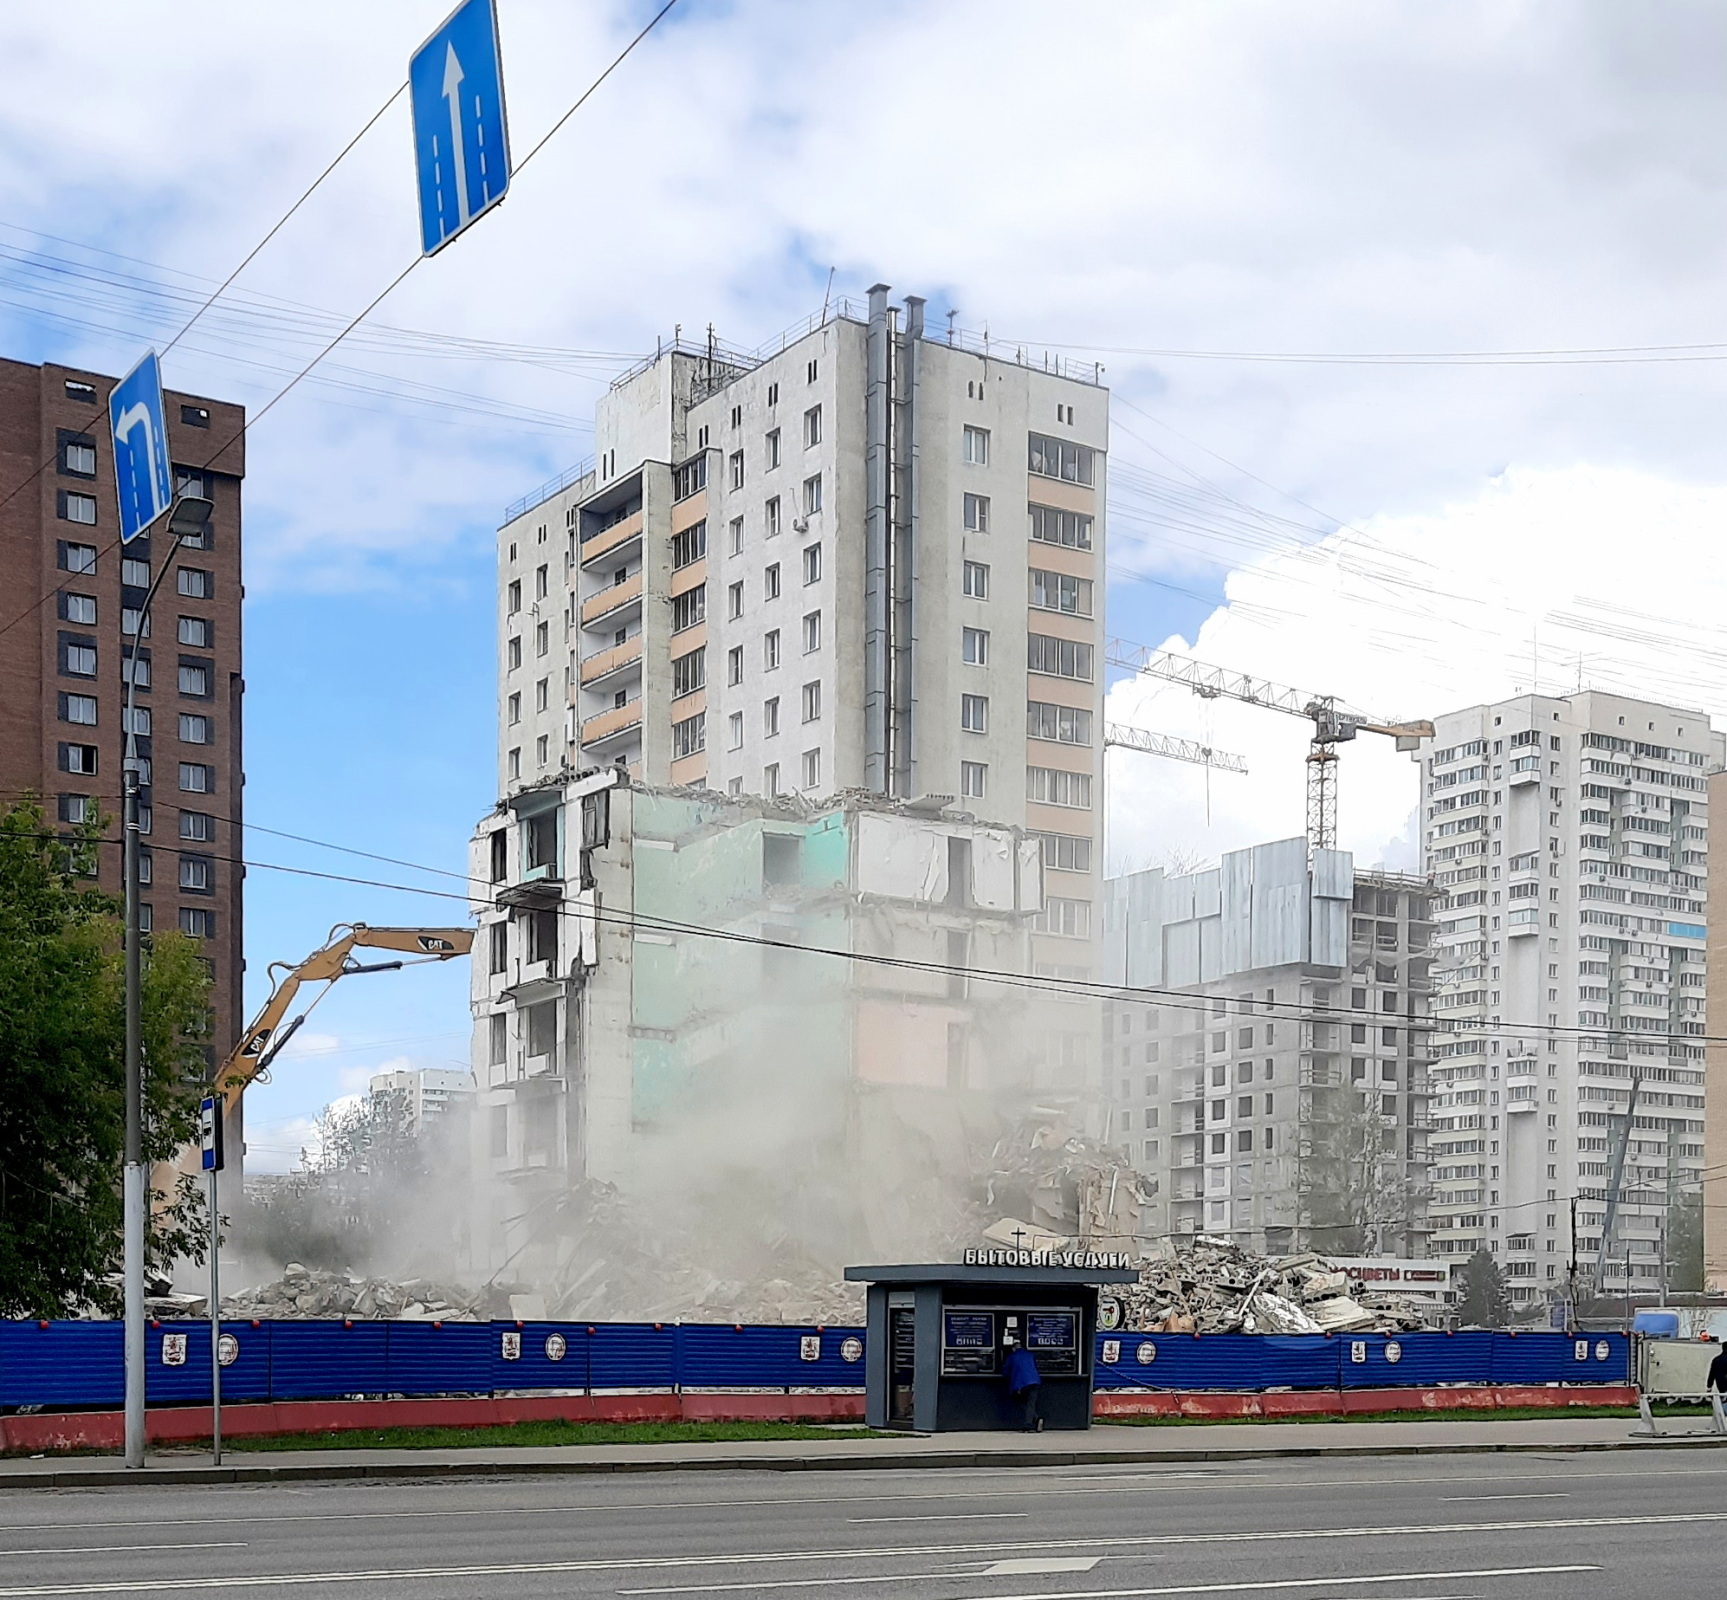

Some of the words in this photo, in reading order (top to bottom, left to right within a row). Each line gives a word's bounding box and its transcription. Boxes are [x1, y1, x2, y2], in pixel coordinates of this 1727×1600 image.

[428, 940, 443, 950] CAT
[250, 1035, 265, 1051] CAT
[965, 1249, 1058, 1266] БЫТОВЫЕ
[1062, 1251, 1130, 1269] УСЛУГИ
